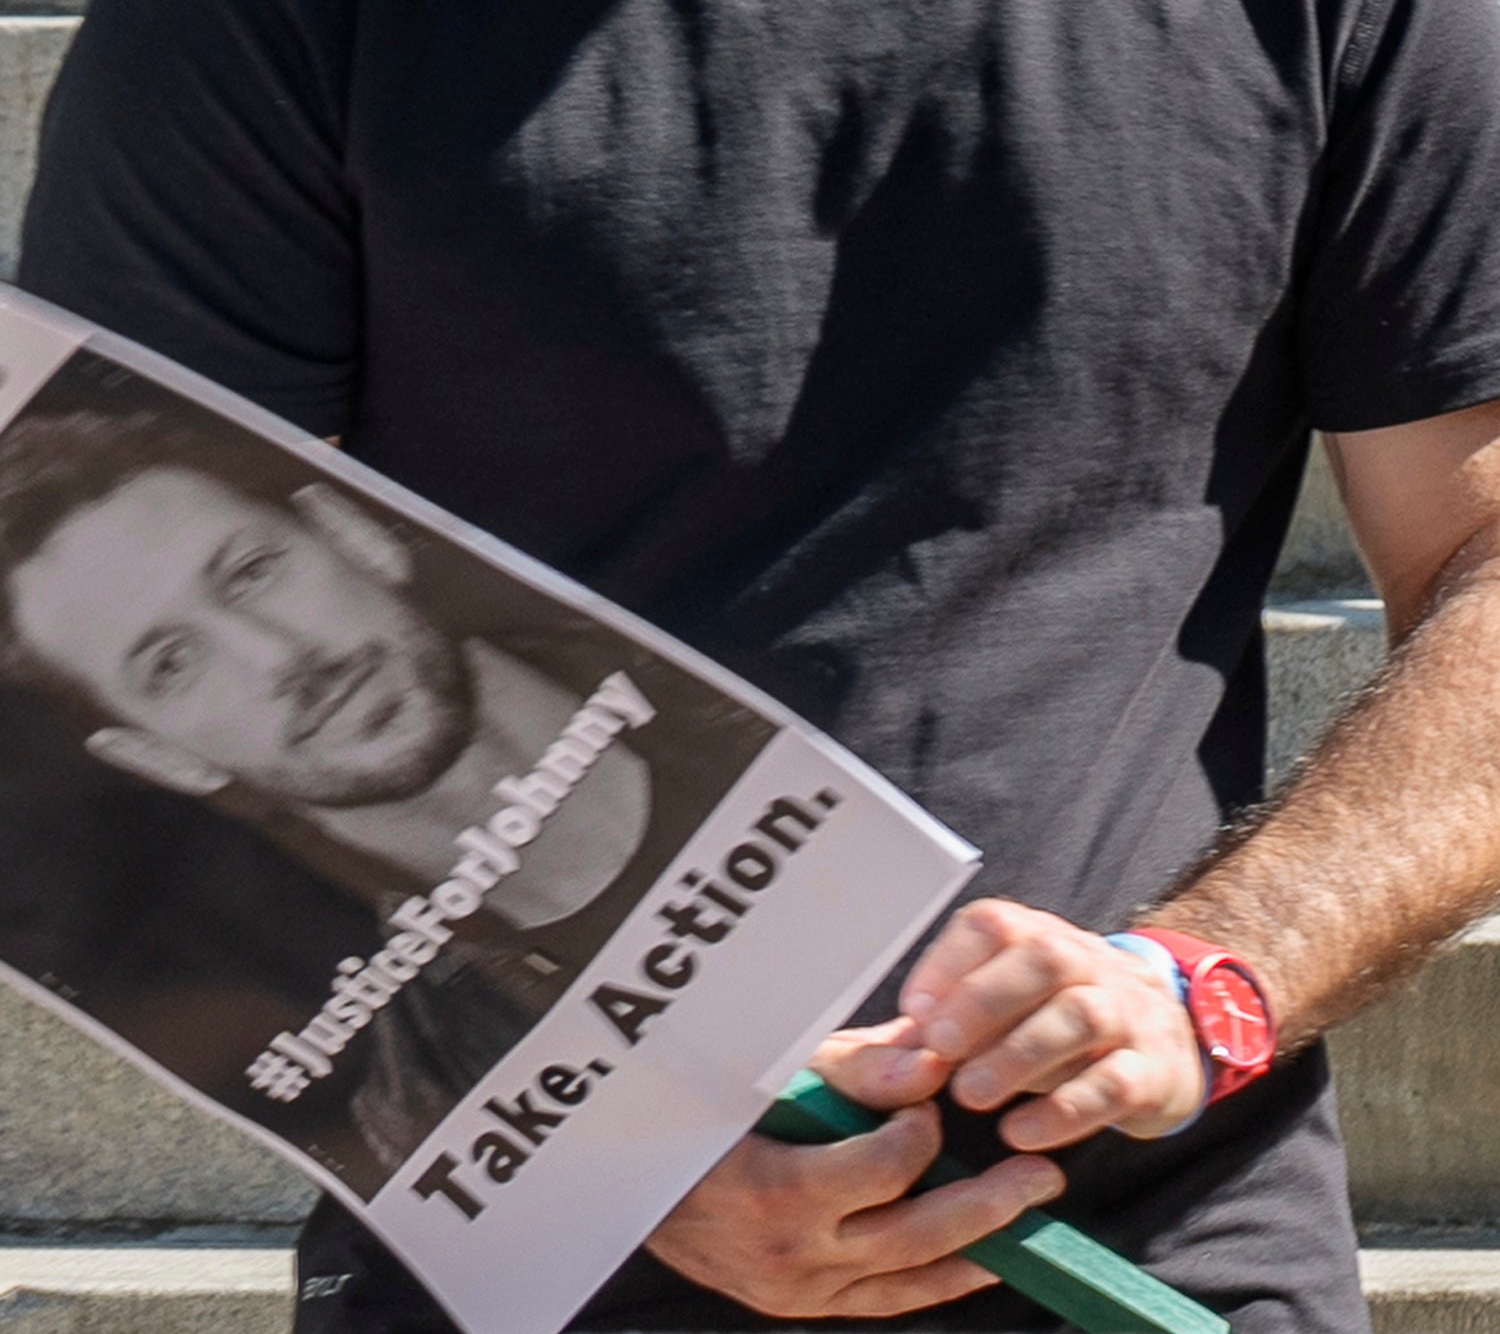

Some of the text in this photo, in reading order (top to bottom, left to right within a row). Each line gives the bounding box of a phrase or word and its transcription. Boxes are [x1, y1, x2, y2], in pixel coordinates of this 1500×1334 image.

[245, 671, 658, 1103] #JusticeForJohnny
[412, 785, 844, 1222] Take. Action.
